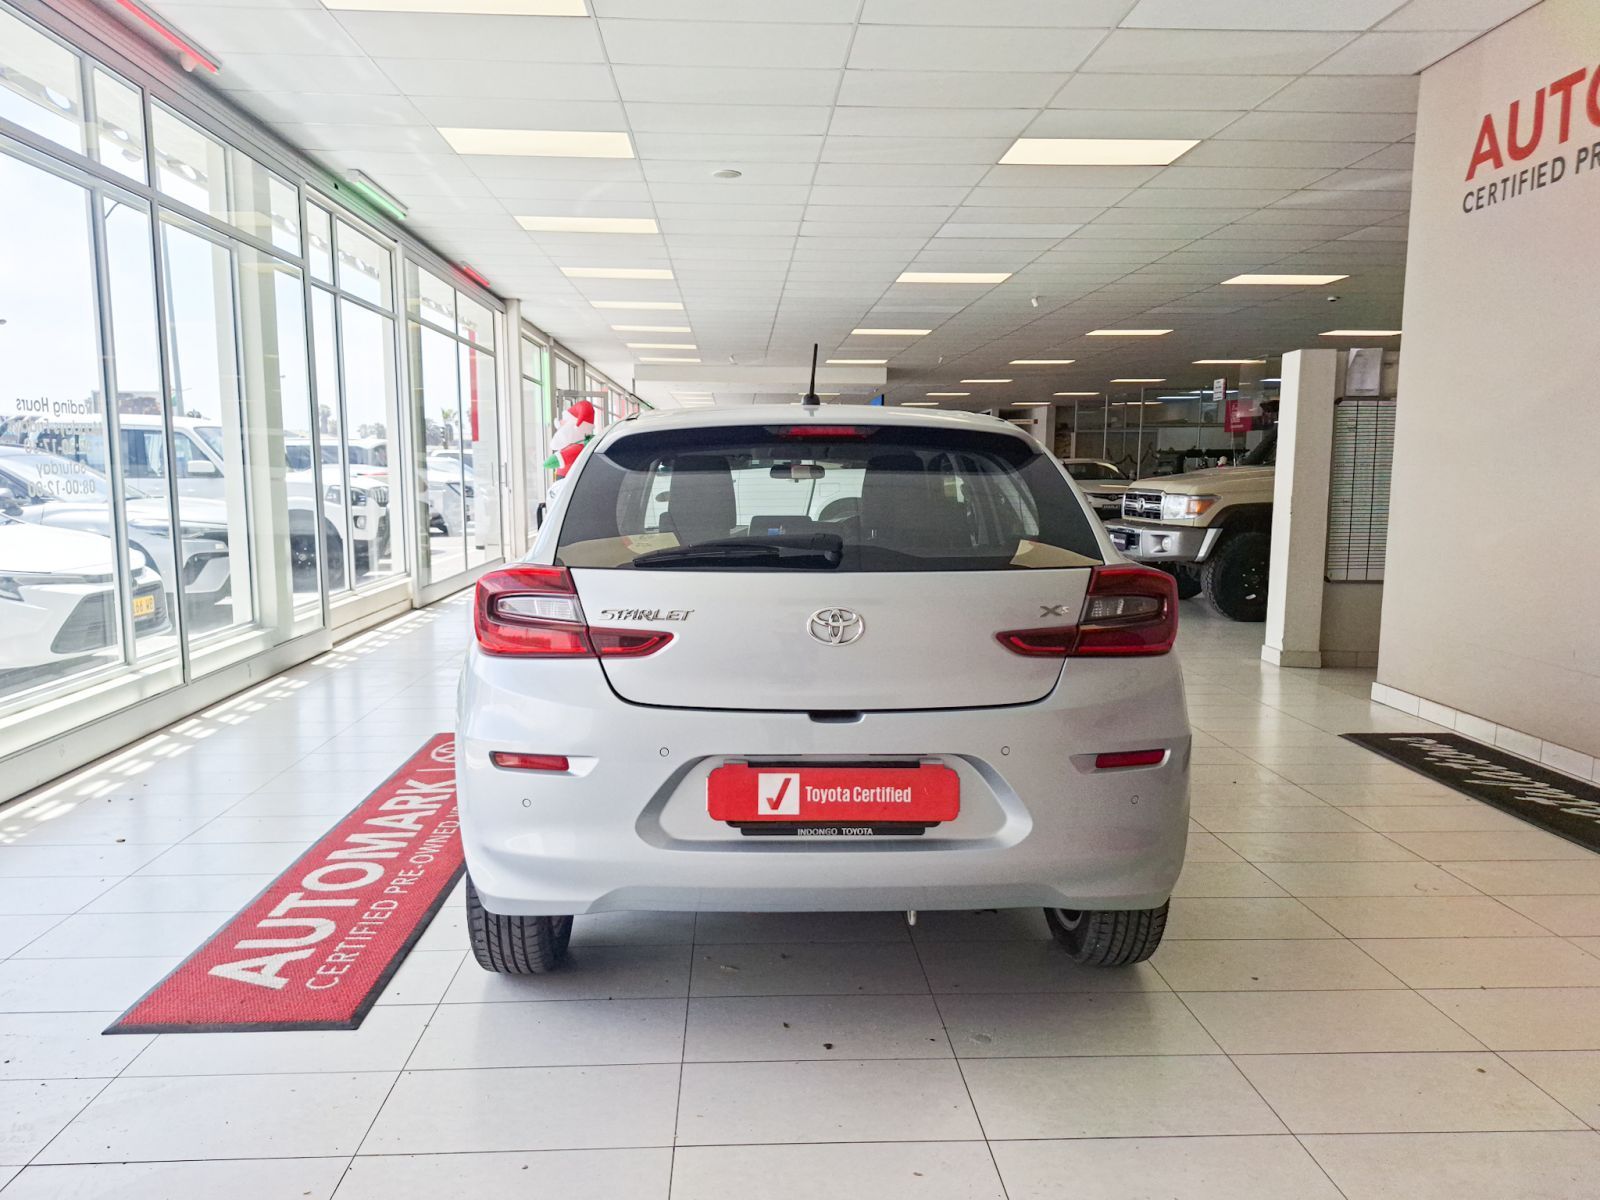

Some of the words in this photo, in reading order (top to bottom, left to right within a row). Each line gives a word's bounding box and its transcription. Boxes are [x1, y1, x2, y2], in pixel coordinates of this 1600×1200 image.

[1462, 156, 1566, 214] CERTIFIED
[600, 608, 695, 621] STARLET
[805, 786, 851, 804] Toyota
[853, 786, 912, 803] Certified
[797, 827, 838, 836] INDONGO
[841, 827, 874, 836] TOYOTA
[208, 779, 456, 990] AUTOMARK
[306, 899, 399, 990] CERTIFIED
[384, 820, 460, 894] PRE-OWNED
